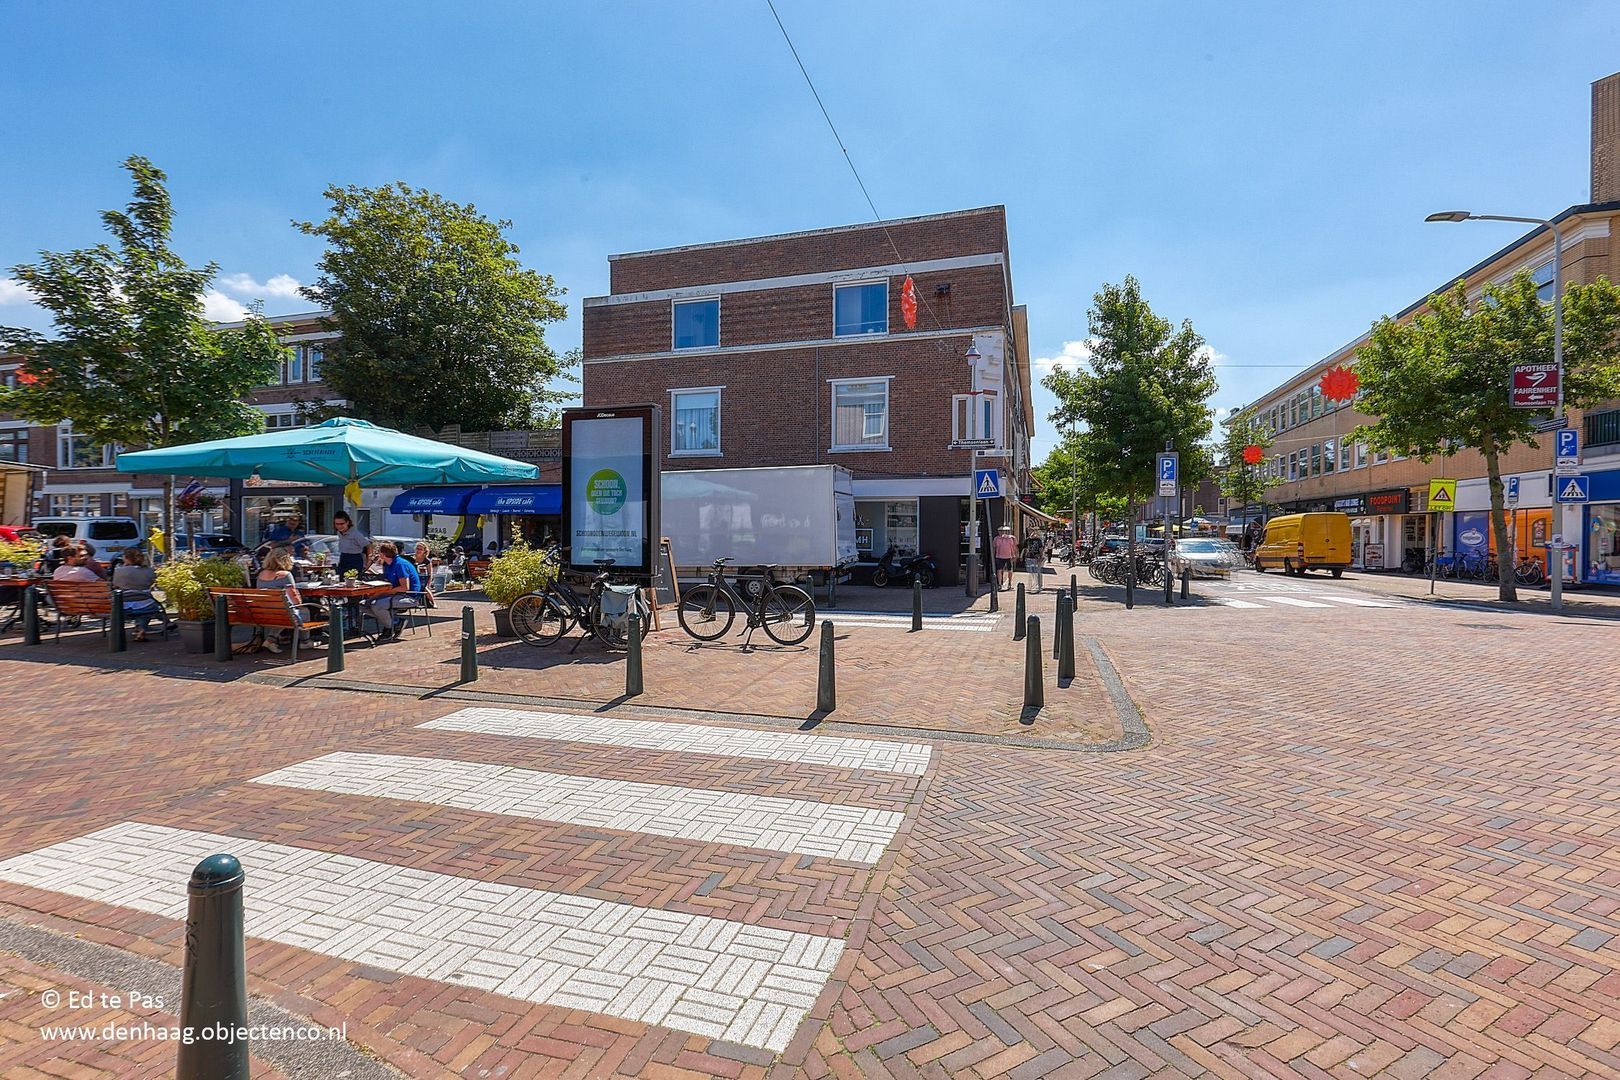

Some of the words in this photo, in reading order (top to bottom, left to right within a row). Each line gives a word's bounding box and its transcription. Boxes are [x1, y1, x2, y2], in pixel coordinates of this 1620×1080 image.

[1514, 364, 1558, 373] APOTHEEK
[1513, 386, 1558, 395] FAHRENHEIT
[1561, 432, 1574, 446] P
[1163, 460, 1172, 472] P
[1510, 478, 1517, 490] P
[1369, 494, 1403, 505] FOODPOINT
